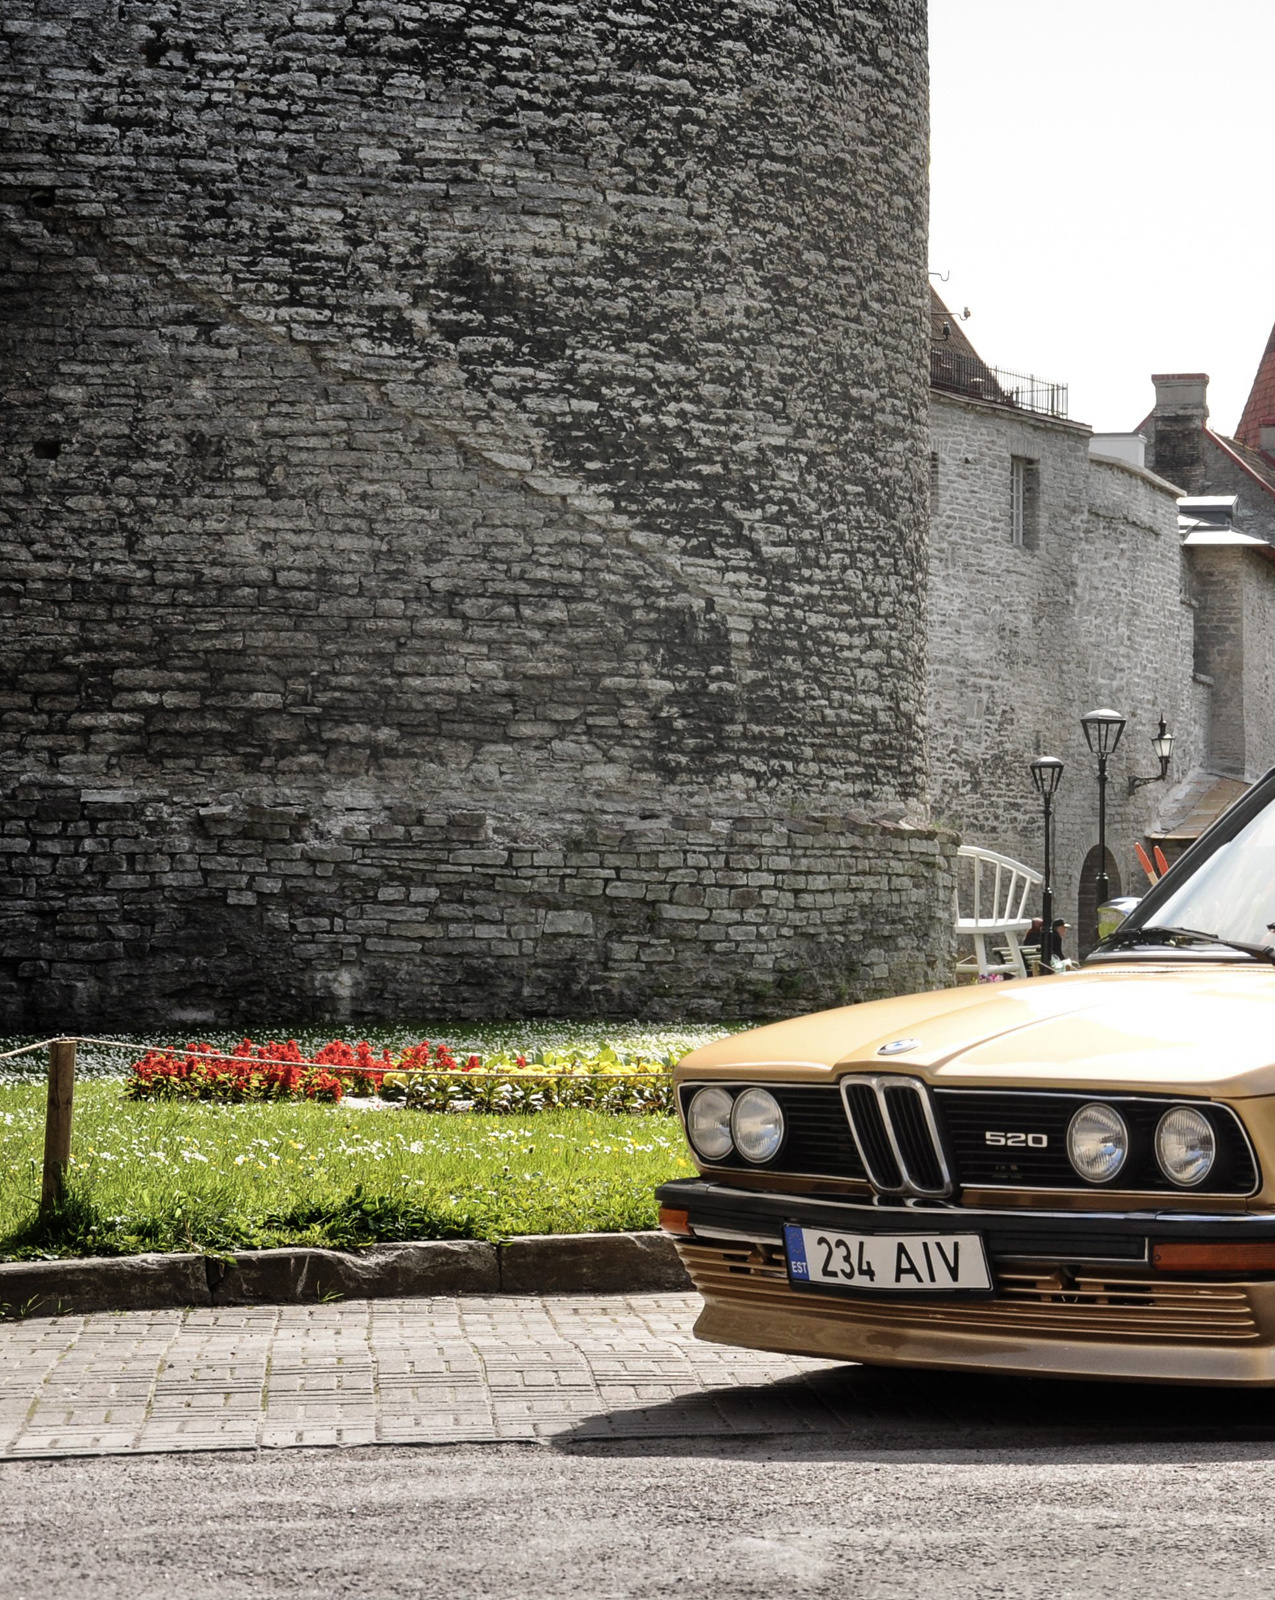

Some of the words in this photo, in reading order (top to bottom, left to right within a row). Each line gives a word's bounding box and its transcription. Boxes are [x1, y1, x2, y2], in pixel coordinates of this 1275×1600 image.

[985, 1131, 1048, 1148] 520
[791, 1261, 807, 1274] EST
[817, 1236, 876, 1282] 234
[894, 1241, 959, 1283] AIV
